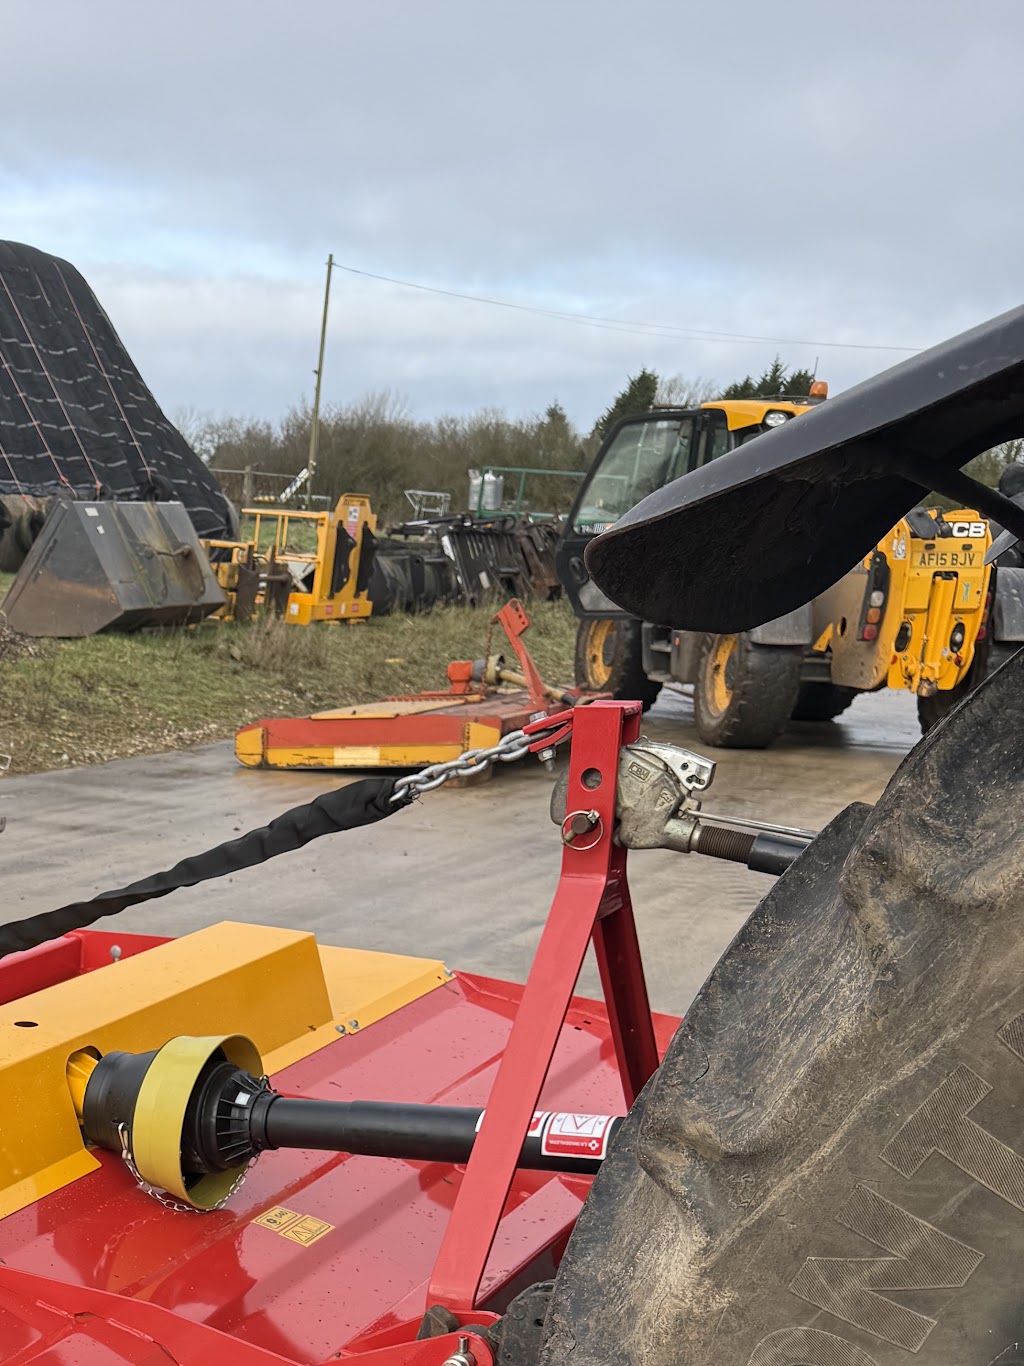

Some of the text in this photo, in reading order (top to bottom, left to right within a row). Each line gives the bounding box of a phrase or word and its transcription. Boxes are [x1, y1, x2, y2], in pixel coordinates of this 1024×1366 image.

[949, 521, 986, 538] CB
[920, 552, 975, 566] AF15 BJV
